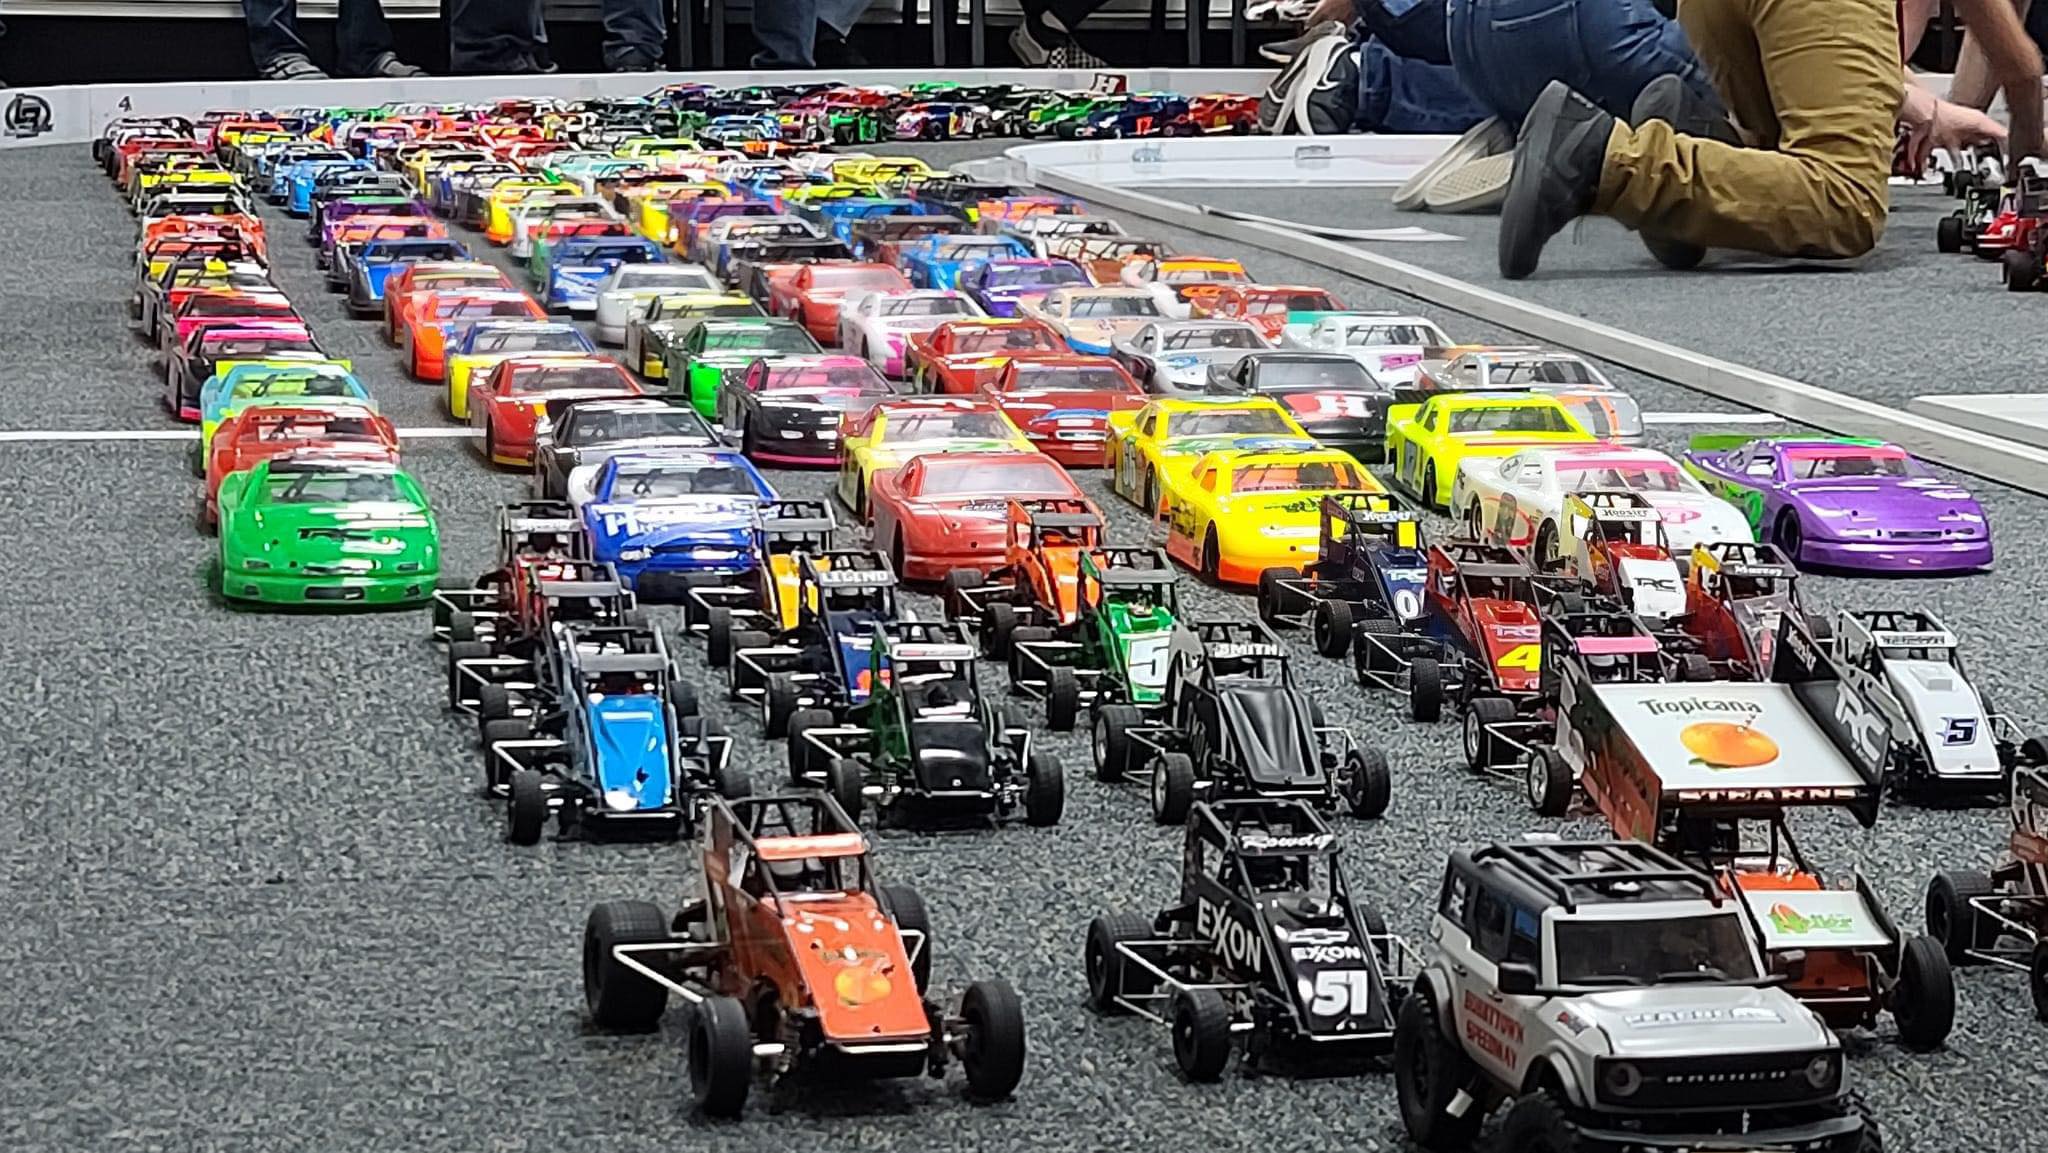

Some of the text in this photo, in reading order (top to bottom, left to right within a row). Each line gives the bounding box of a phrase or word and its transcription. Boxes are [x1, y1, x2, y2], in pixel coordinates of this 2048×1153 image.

[821, 570, 889, 583] LEGEND
[1633, 576, 1677, 592] TRC
[1490, 624, 1541, 638] TRC
[1213, 642, 1282, 657] SMITH
[1496, 644, 1541, 672] 4
[1638, 696, 1764, 716] Tropicana
[1936, 716, 1979, 747] 5
[1241, 833, 1335, 850] Rowdy
[1197, 895, 1261, 974] EXXON
[1291, 946, 1362, 964] EXXON
[1311, 969, 1368, 1017] 51
